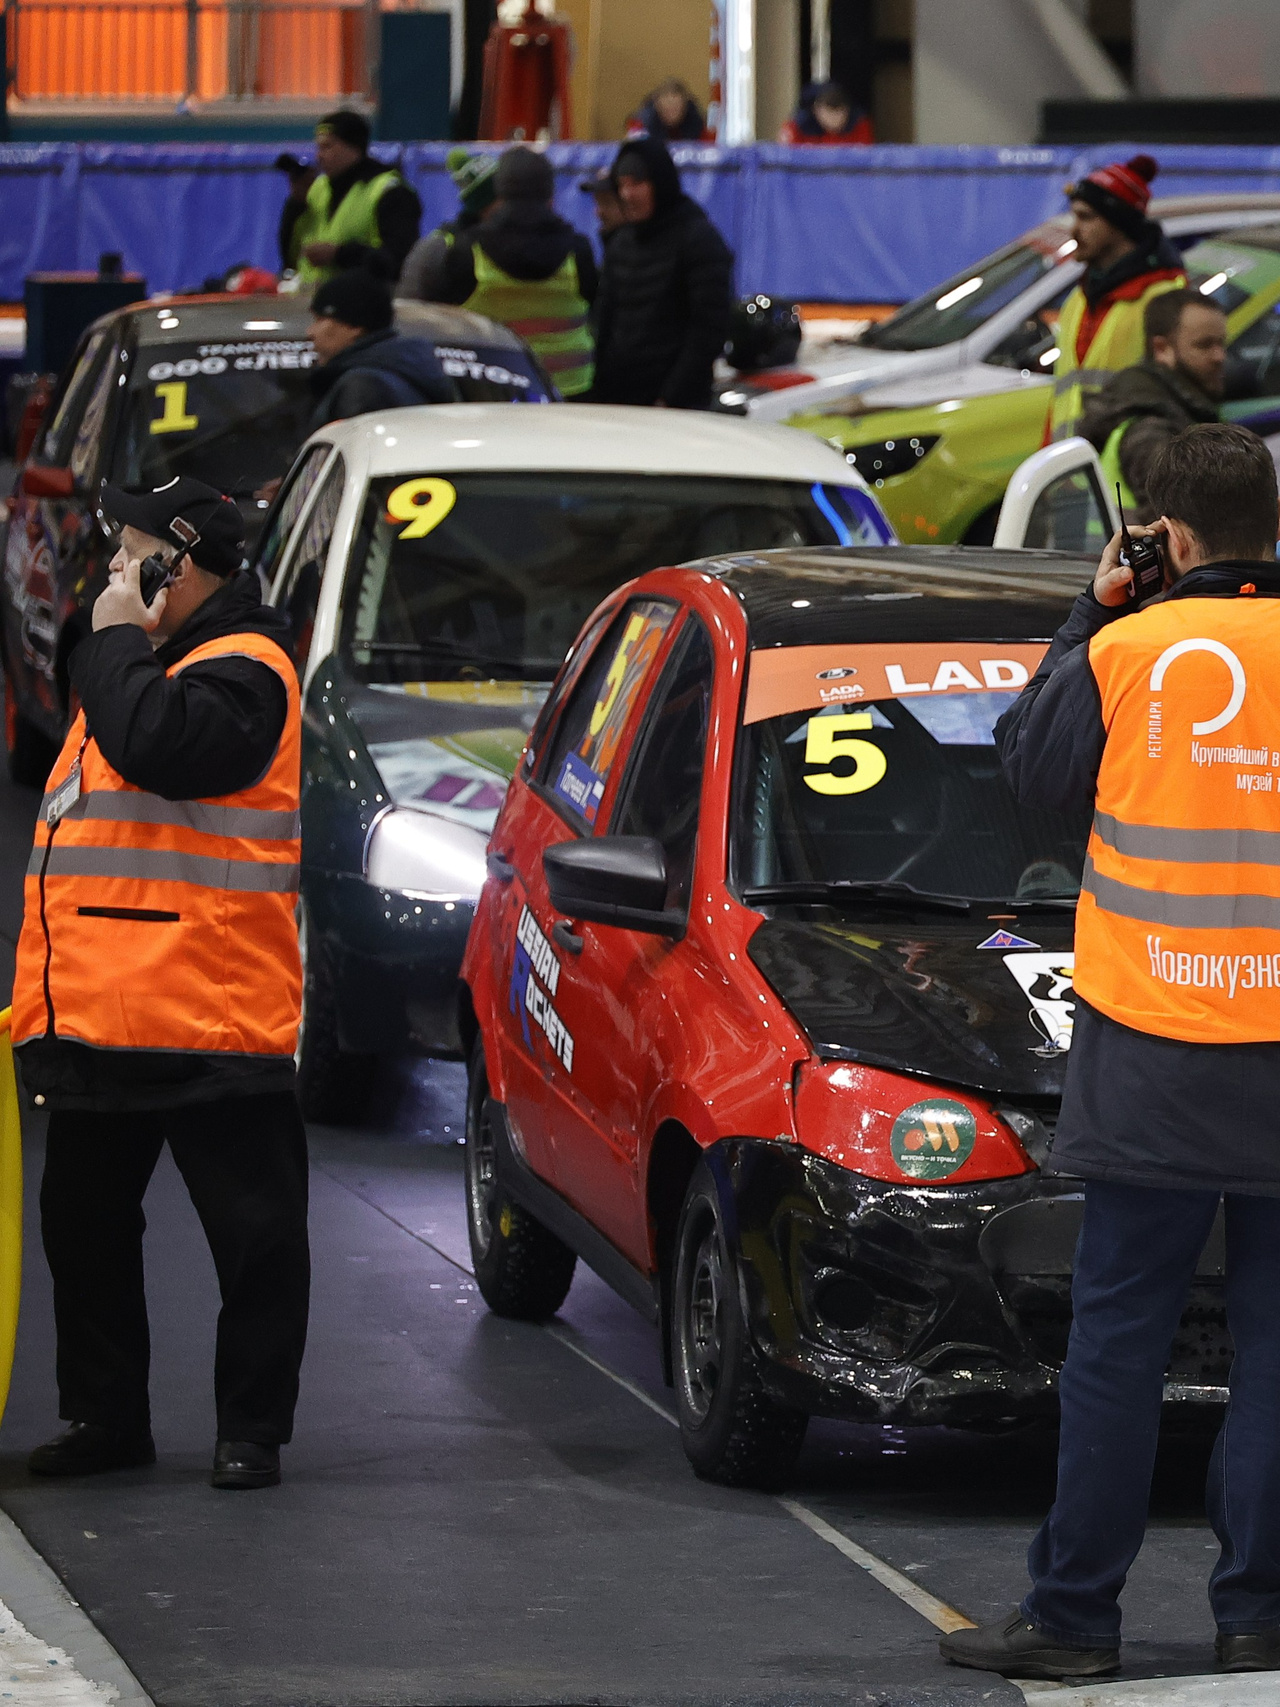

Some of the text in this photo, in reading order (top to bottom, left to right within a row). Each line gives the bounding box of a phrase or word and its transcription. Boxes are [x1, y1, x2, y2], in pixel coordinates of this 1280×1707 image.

[148, 357, 229, 380] ООО
[150, 381, 199, 434] 1
[386, 477, 457, 540] 9
[590, 615, 645, 736] 5
[819, 684, 865, 698] LADA
[884, 659, 1036, 694] LAD
[1148, 701, 1163, 758] РЕТРОПАРК
[803, 713, 887, 795] 5
[1191, 741, 1269, 767] Крупнейший
[1271, 751, 1280, 767] в
[1236, 772, 1272, 794] музей
